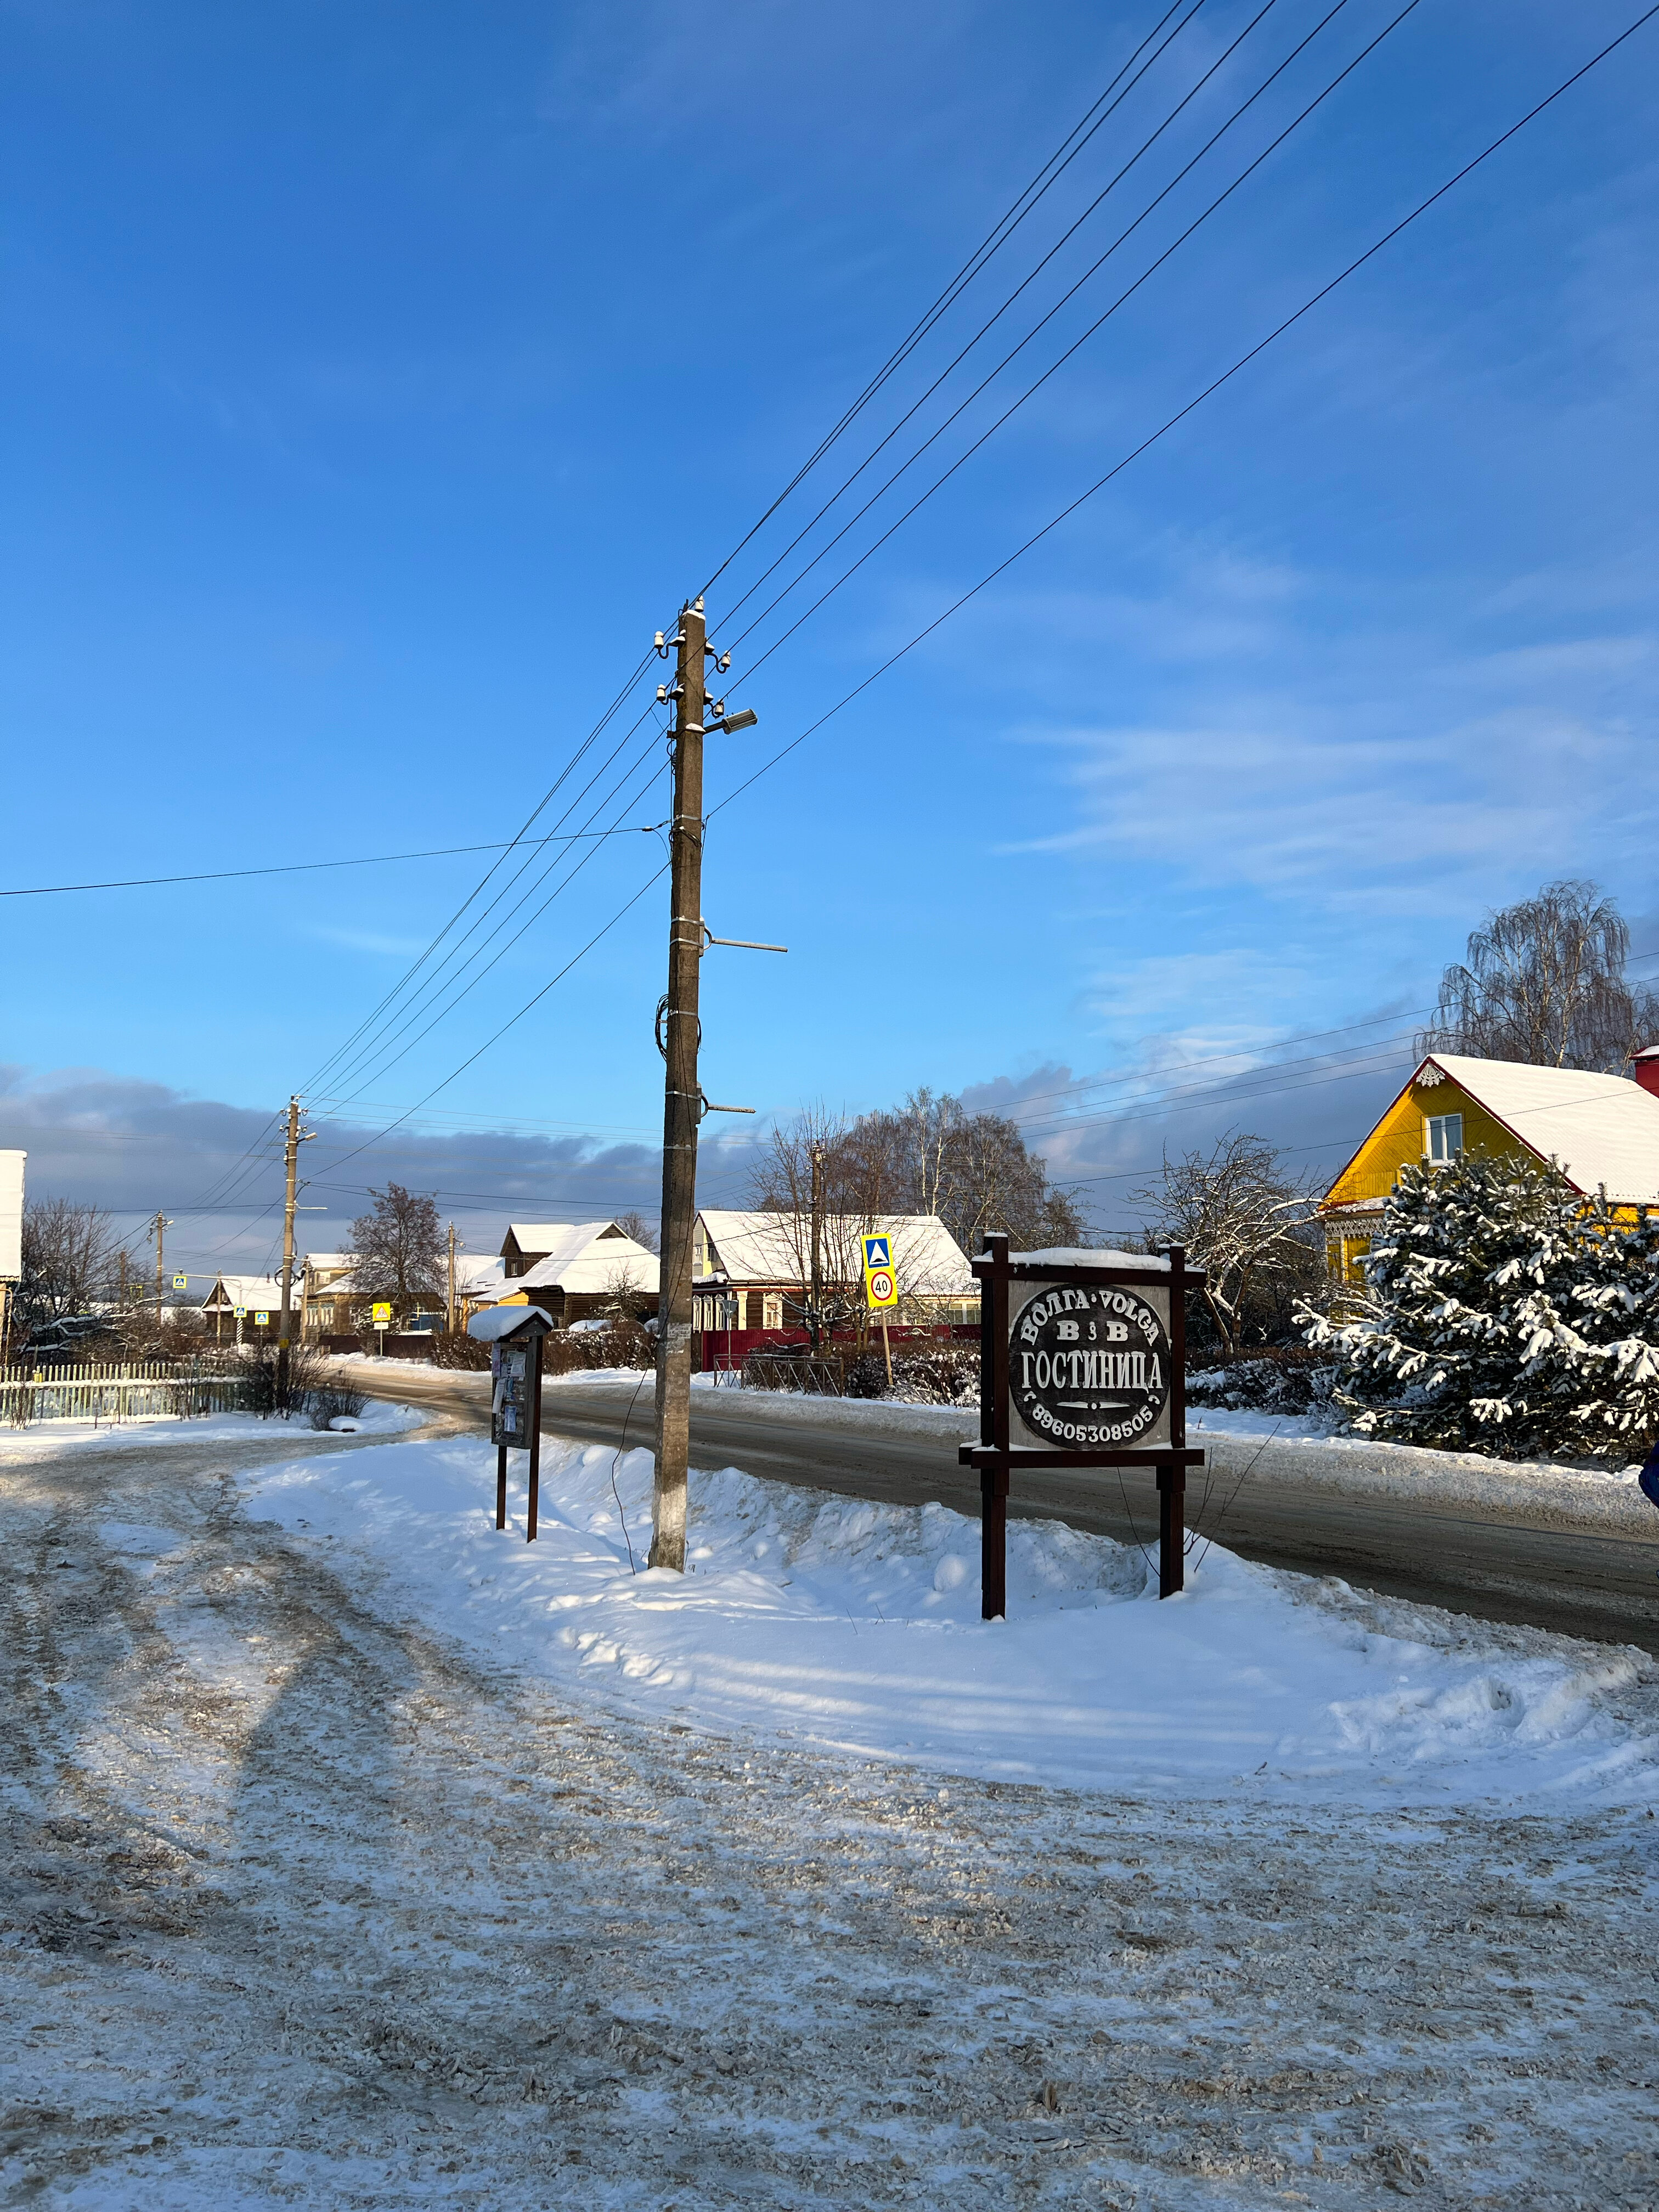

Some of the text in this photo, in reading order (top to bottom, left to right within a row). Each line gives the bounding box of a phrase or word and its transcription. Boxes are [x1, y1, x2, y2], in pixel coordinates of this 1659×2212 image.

[875, 1280, 888, 1293] 40
[1021, 1290, 1090, 1345] ВОЛГА
[1099, 1290, 1159, 1346] VOLGA
[1021, 1350, 1163, 1392] ГОСТИНИЦА
[1032, 1403, 1153, 1442] 89605308505
